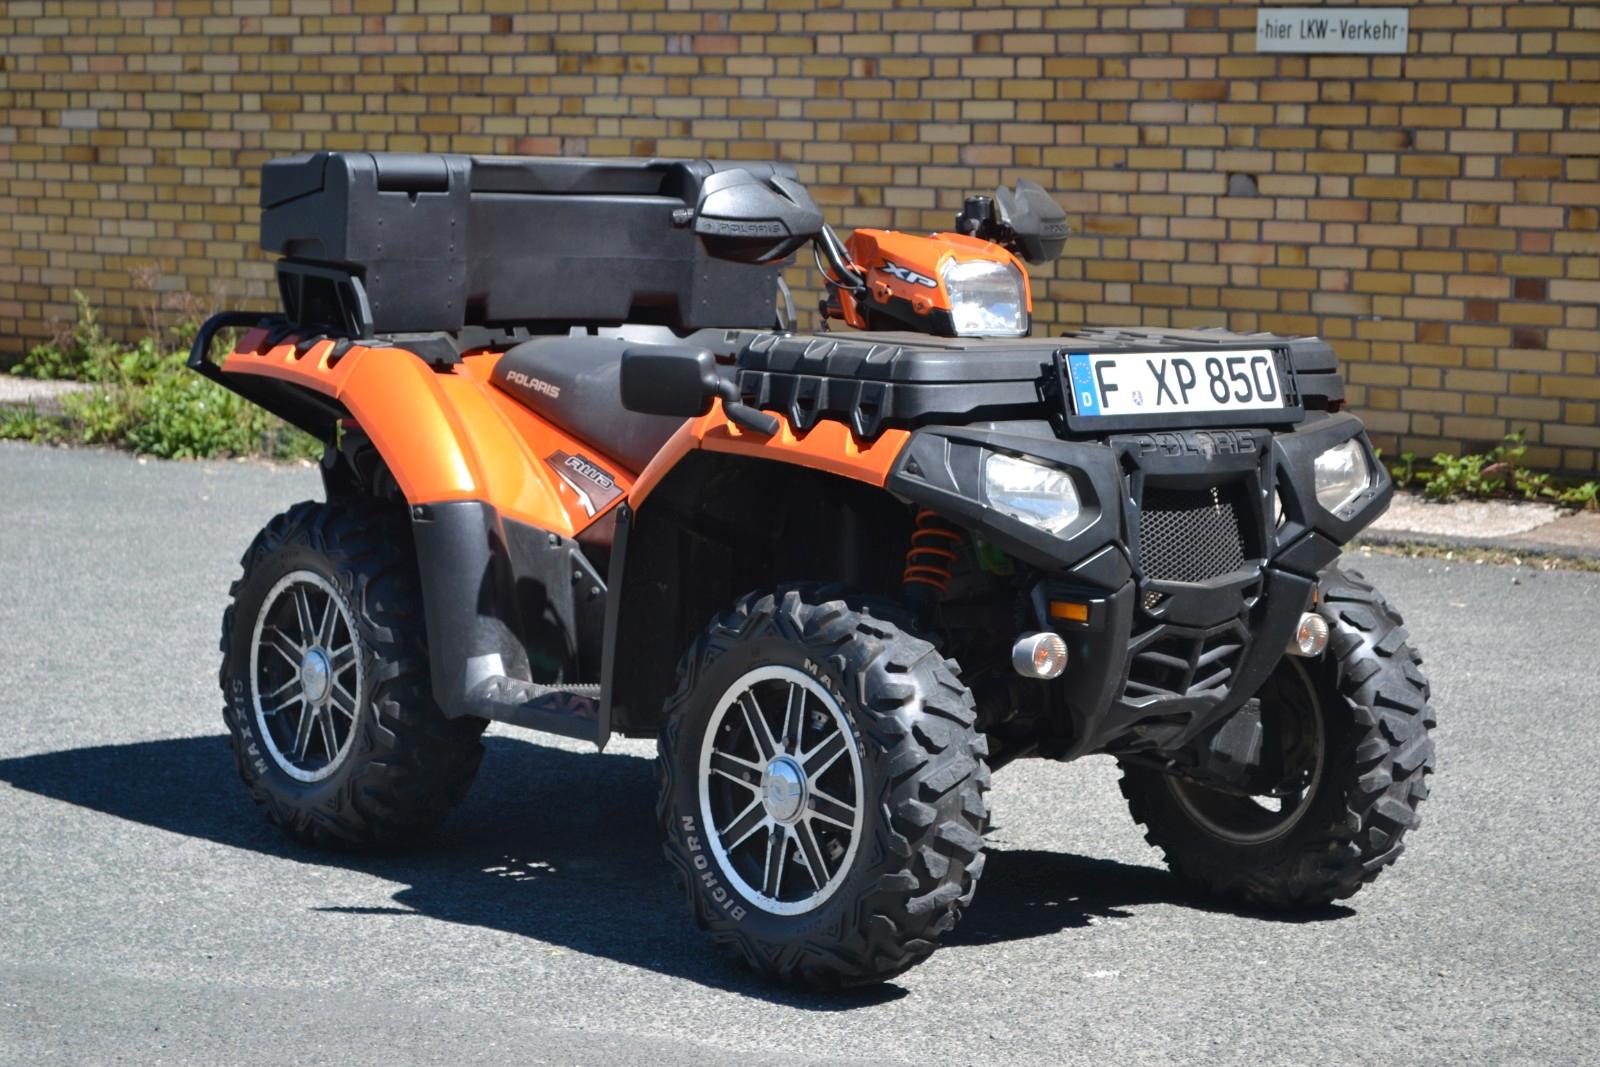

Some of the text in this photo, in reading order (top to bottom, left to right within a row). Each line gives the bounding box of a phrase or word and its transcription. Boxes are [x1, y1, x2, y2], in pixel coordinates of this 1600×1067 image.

[1265, 18, 1292, 39] hier
[720, 222, 781, 233] POLARIS
[879, 259, 938, 288] XP
[506, 370, 560, 399] POLARIS
[1095, 356, 1277, 408] F XP 850
[1081, 391, 1093, 407] D
[1132, 430, 1257, 458] POLARIS
[804, 657, 866, 759] MAXXIS
[232, 680, 269, 775] MAXXIS
[682, 815, 747, 921] BIGHORN
